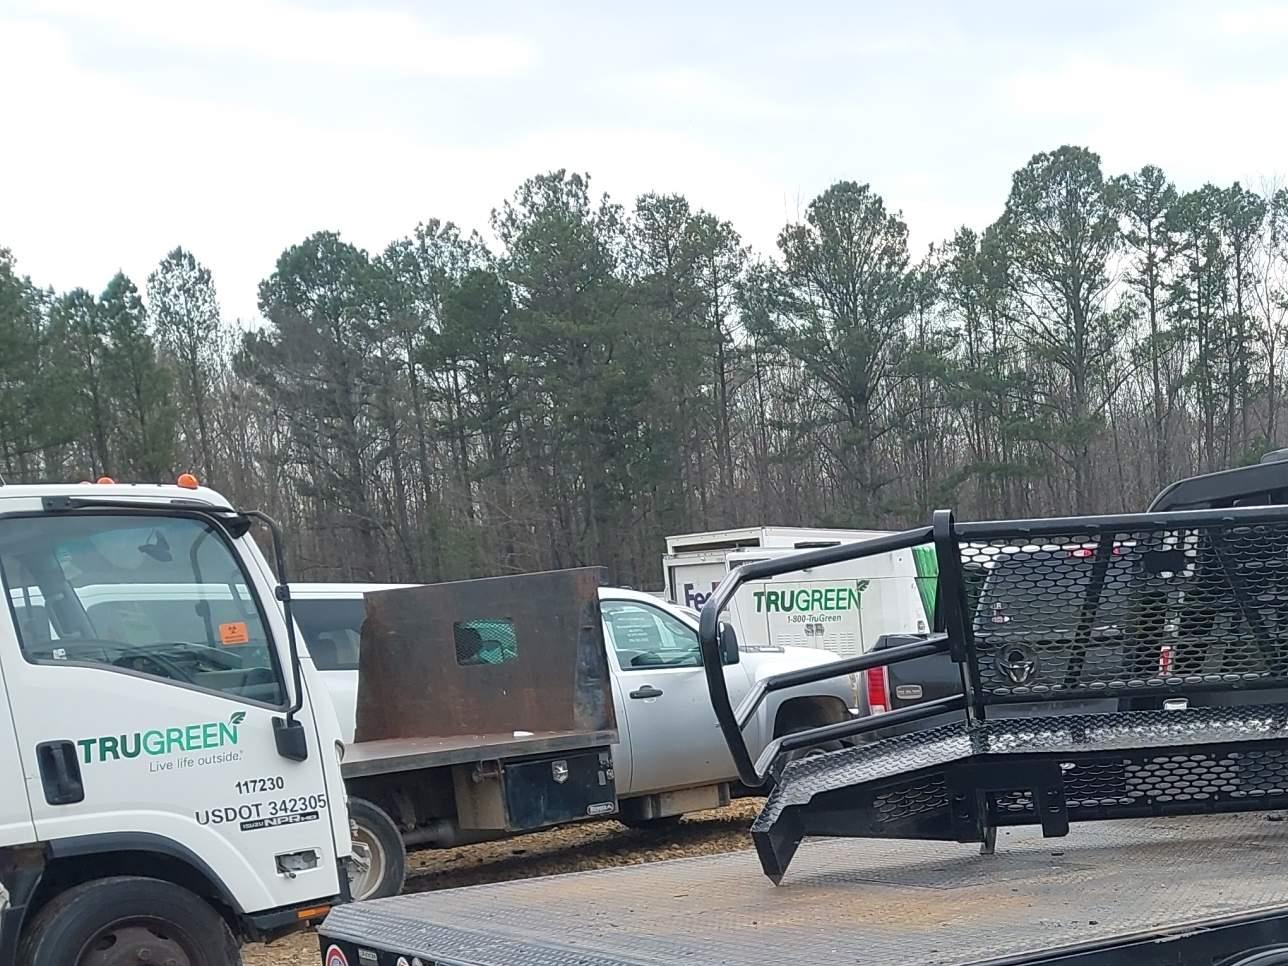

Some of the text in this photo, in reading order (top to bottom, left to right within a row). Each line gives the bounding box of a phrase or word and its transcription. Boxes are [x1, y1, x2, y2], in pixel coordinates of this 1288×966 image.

[754, 587, 862, 613] TRUGREEN
[787, 614, 842, 623] 1-800-TruGreen
[78, 722, 239, 764] TRUGREEN
[149, 761, 174, 773] Live
[177, 755, 194, 768] life
[235, 776, 284, 795] 117230
[195, 793, 327, 826] USDOT 342305
[264, 814, 300, 827] NPR
